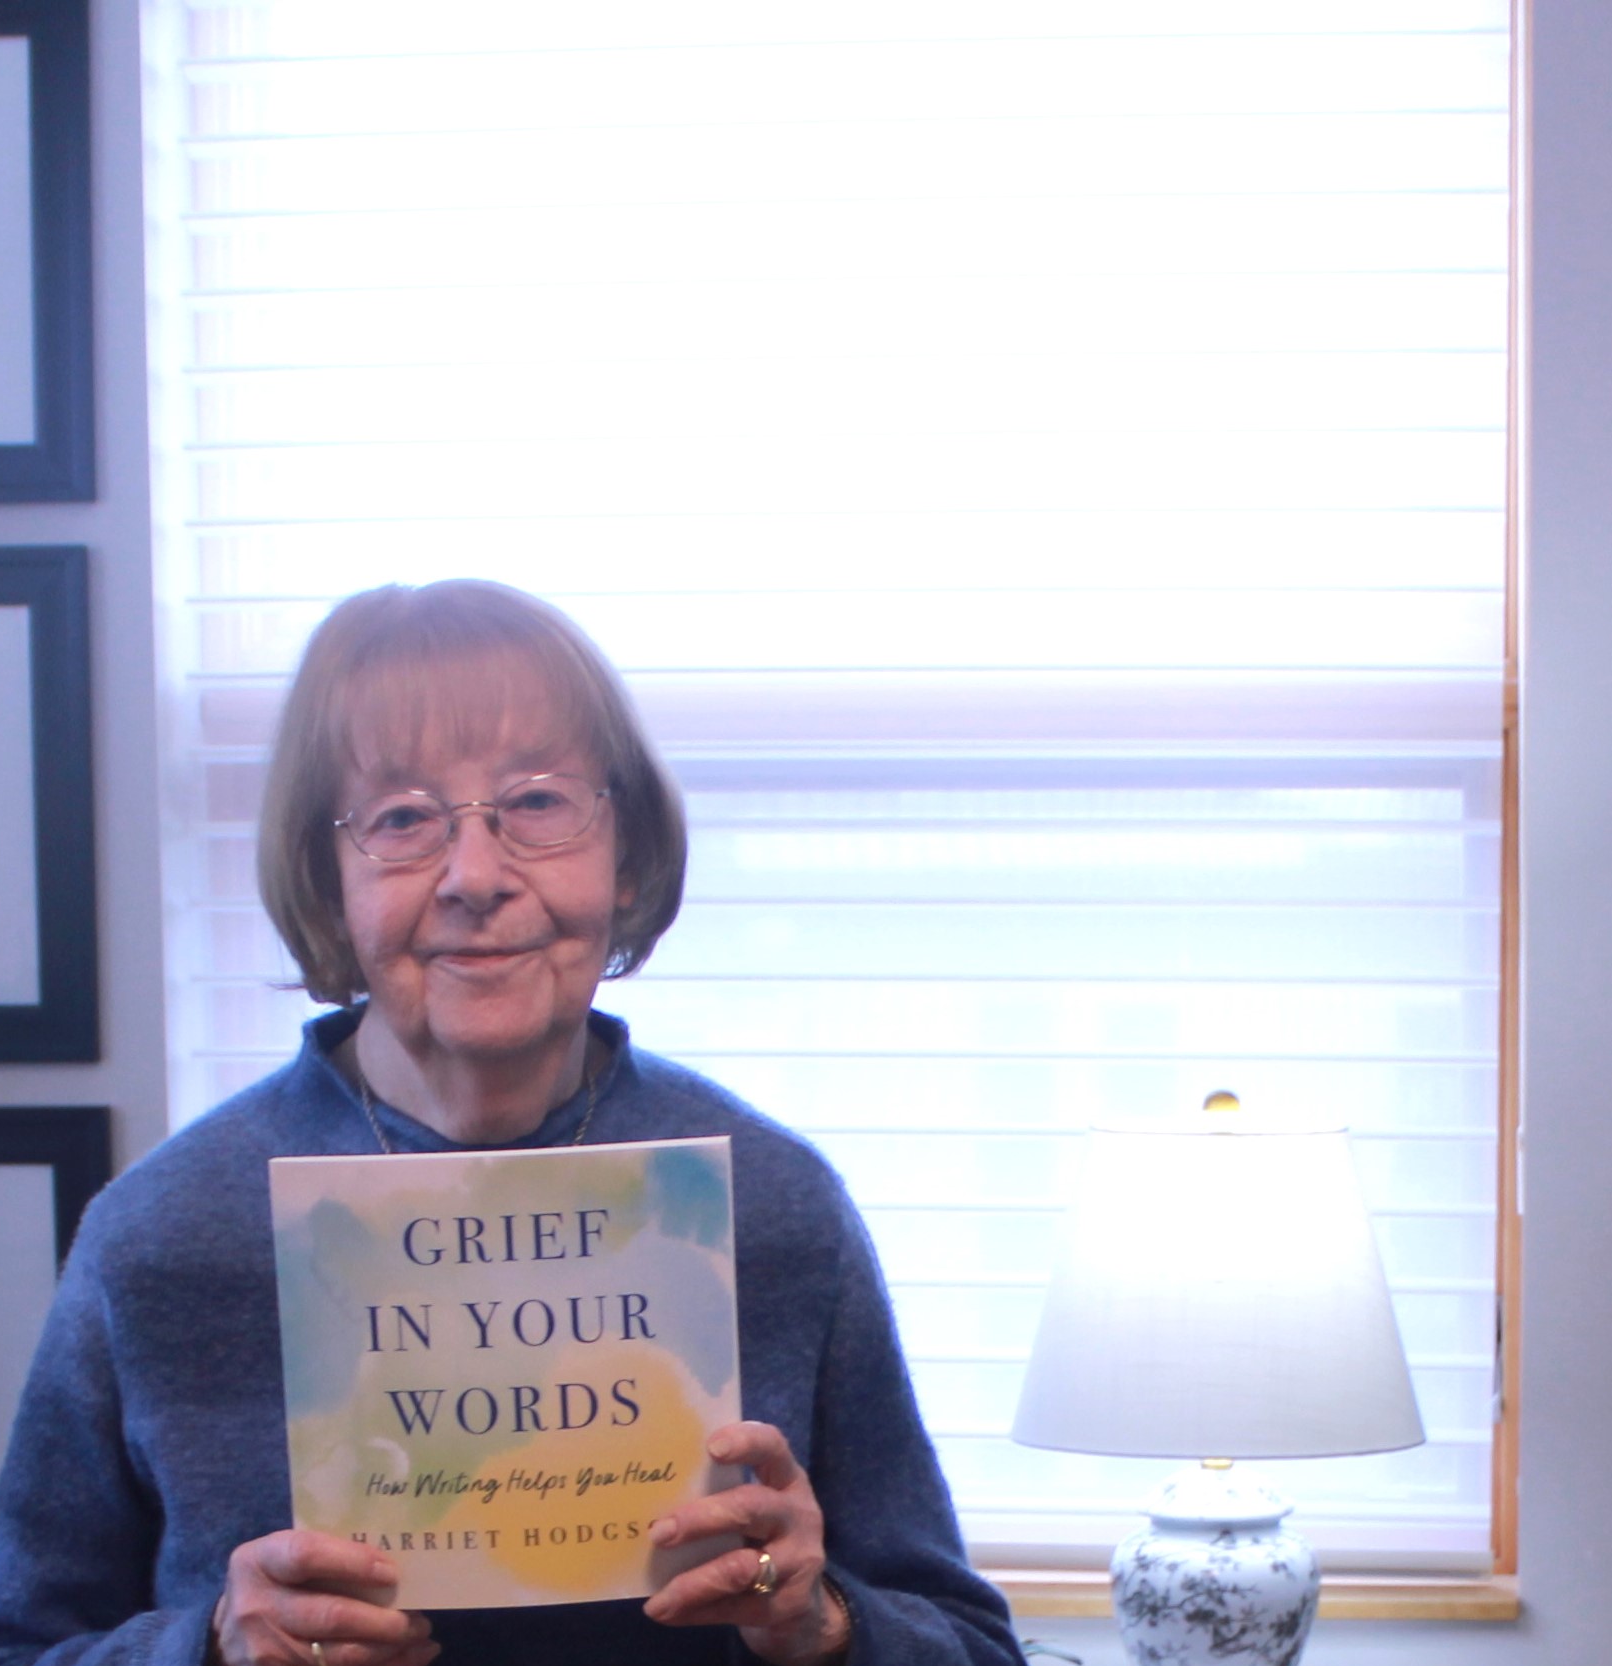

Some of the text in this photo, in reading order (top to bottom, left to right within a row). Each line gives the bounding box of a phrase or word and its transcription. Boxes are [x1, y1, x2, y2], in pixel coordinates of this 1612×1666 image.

[403, 1209, 610, 1266] GRIEF
[365, 1292, 656, 1352] IN YOUR
[384, 1378, 640, 1437] WORDS
[366, 1462, 676, 1504] How Writing Helps You Heal
[351, 1519, 659, 1550] HARRIET HODGS
